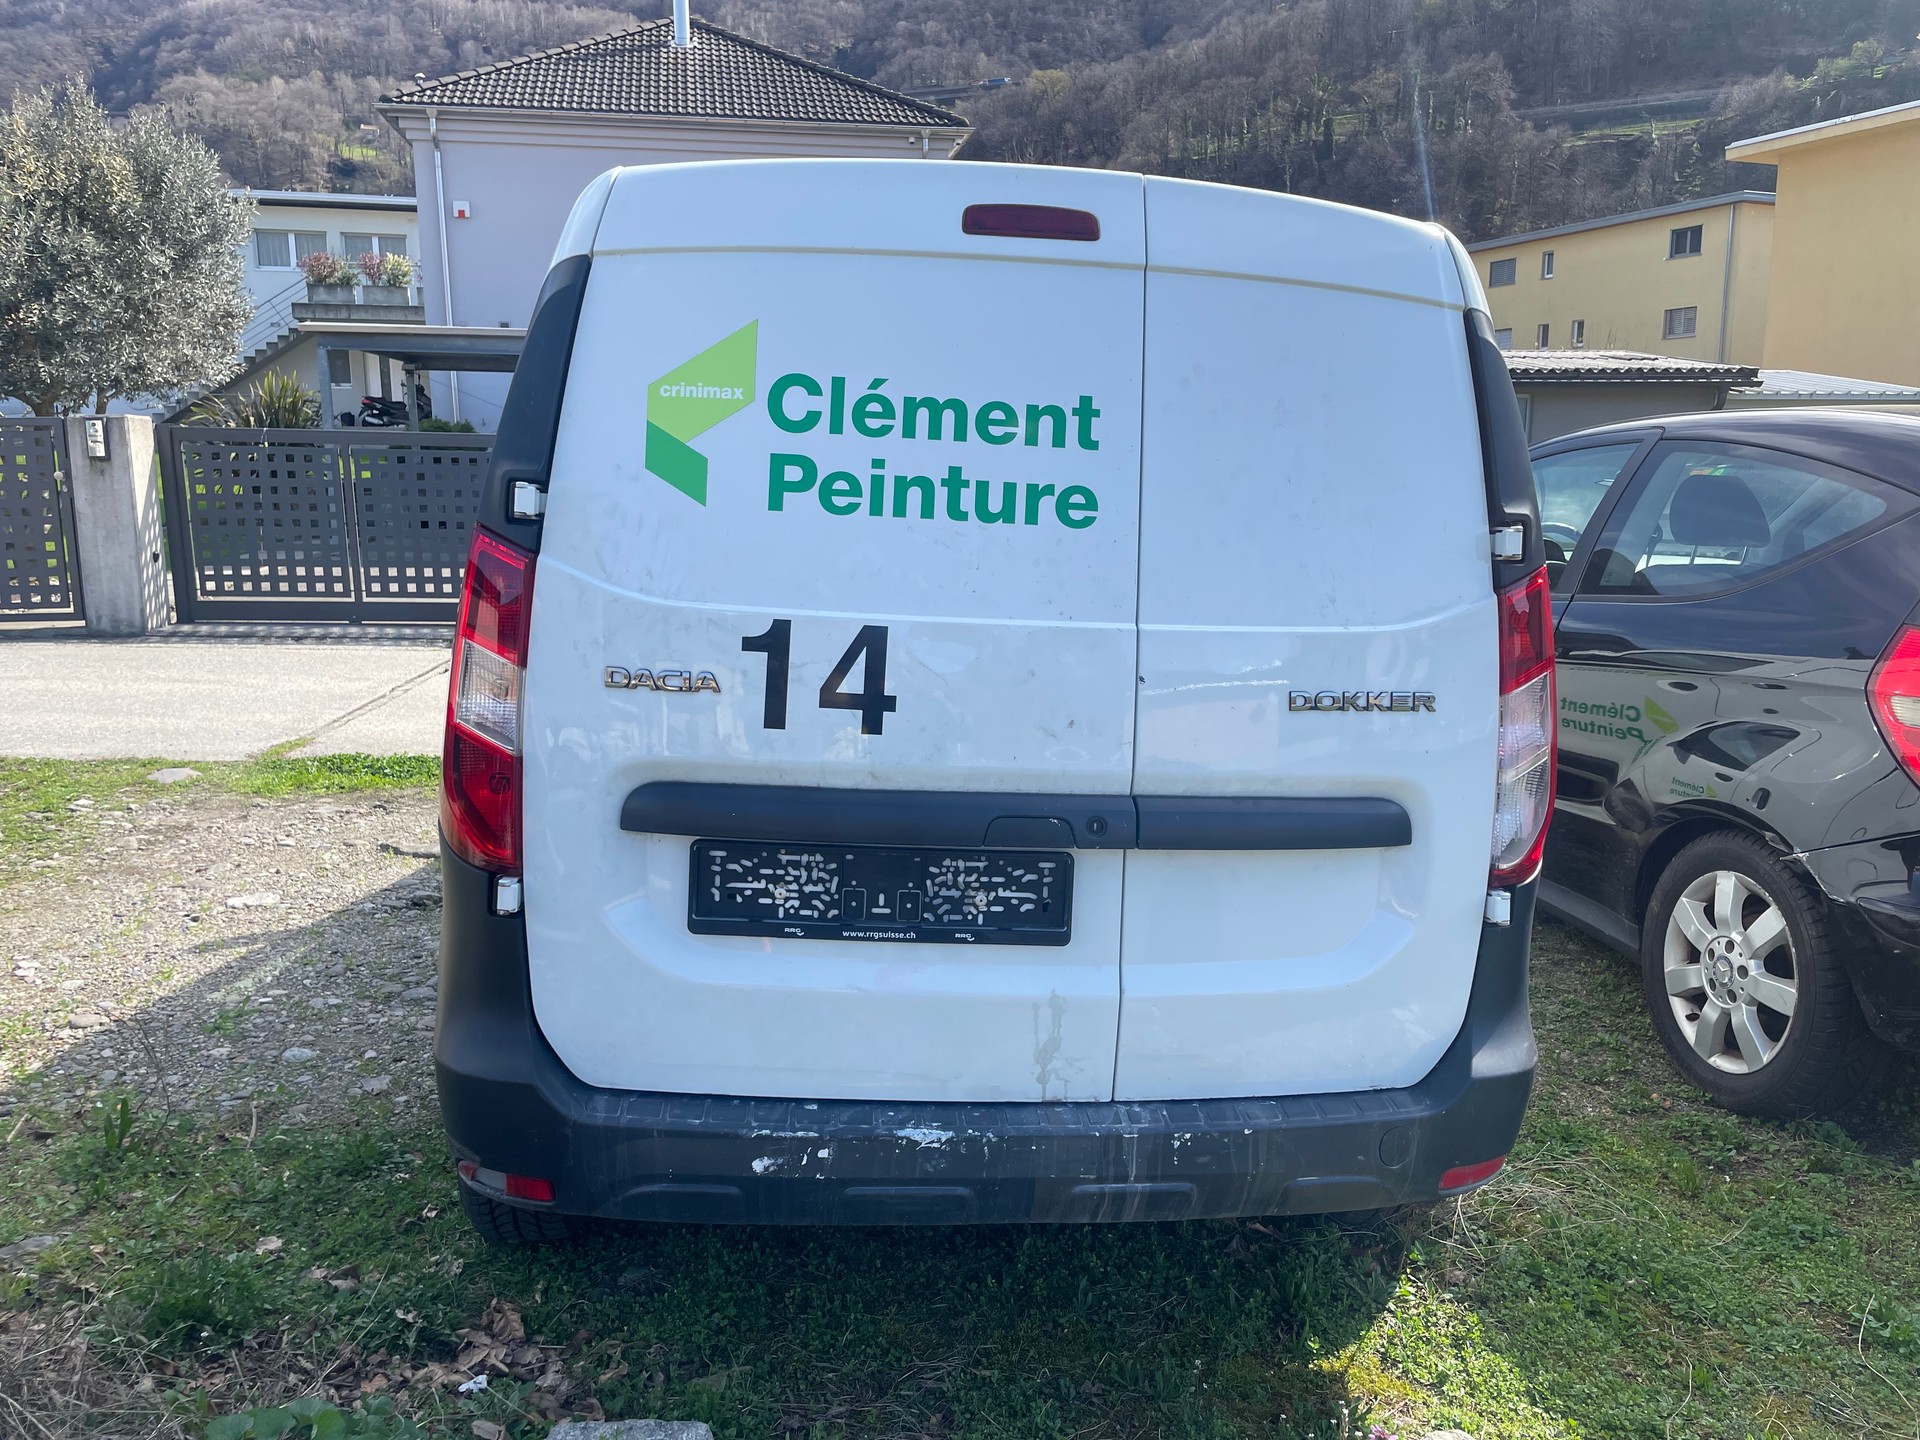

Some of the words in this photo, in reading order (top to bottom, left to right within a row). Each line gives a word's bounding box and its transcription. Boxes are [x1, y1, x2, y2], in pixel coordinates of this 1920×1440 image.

[660, 382, 744, 400] crinimax
[767, 373, 1101, 451] Clément
[767, 453, 1099, 529] Peinture
[603, 665, 721, 693] DACIA
[741, 618, 897, 735] 14
[1289, 691, 1437, 712] DOKKER
[842, 929, 916, 940] www.rrgsuisse.ch
